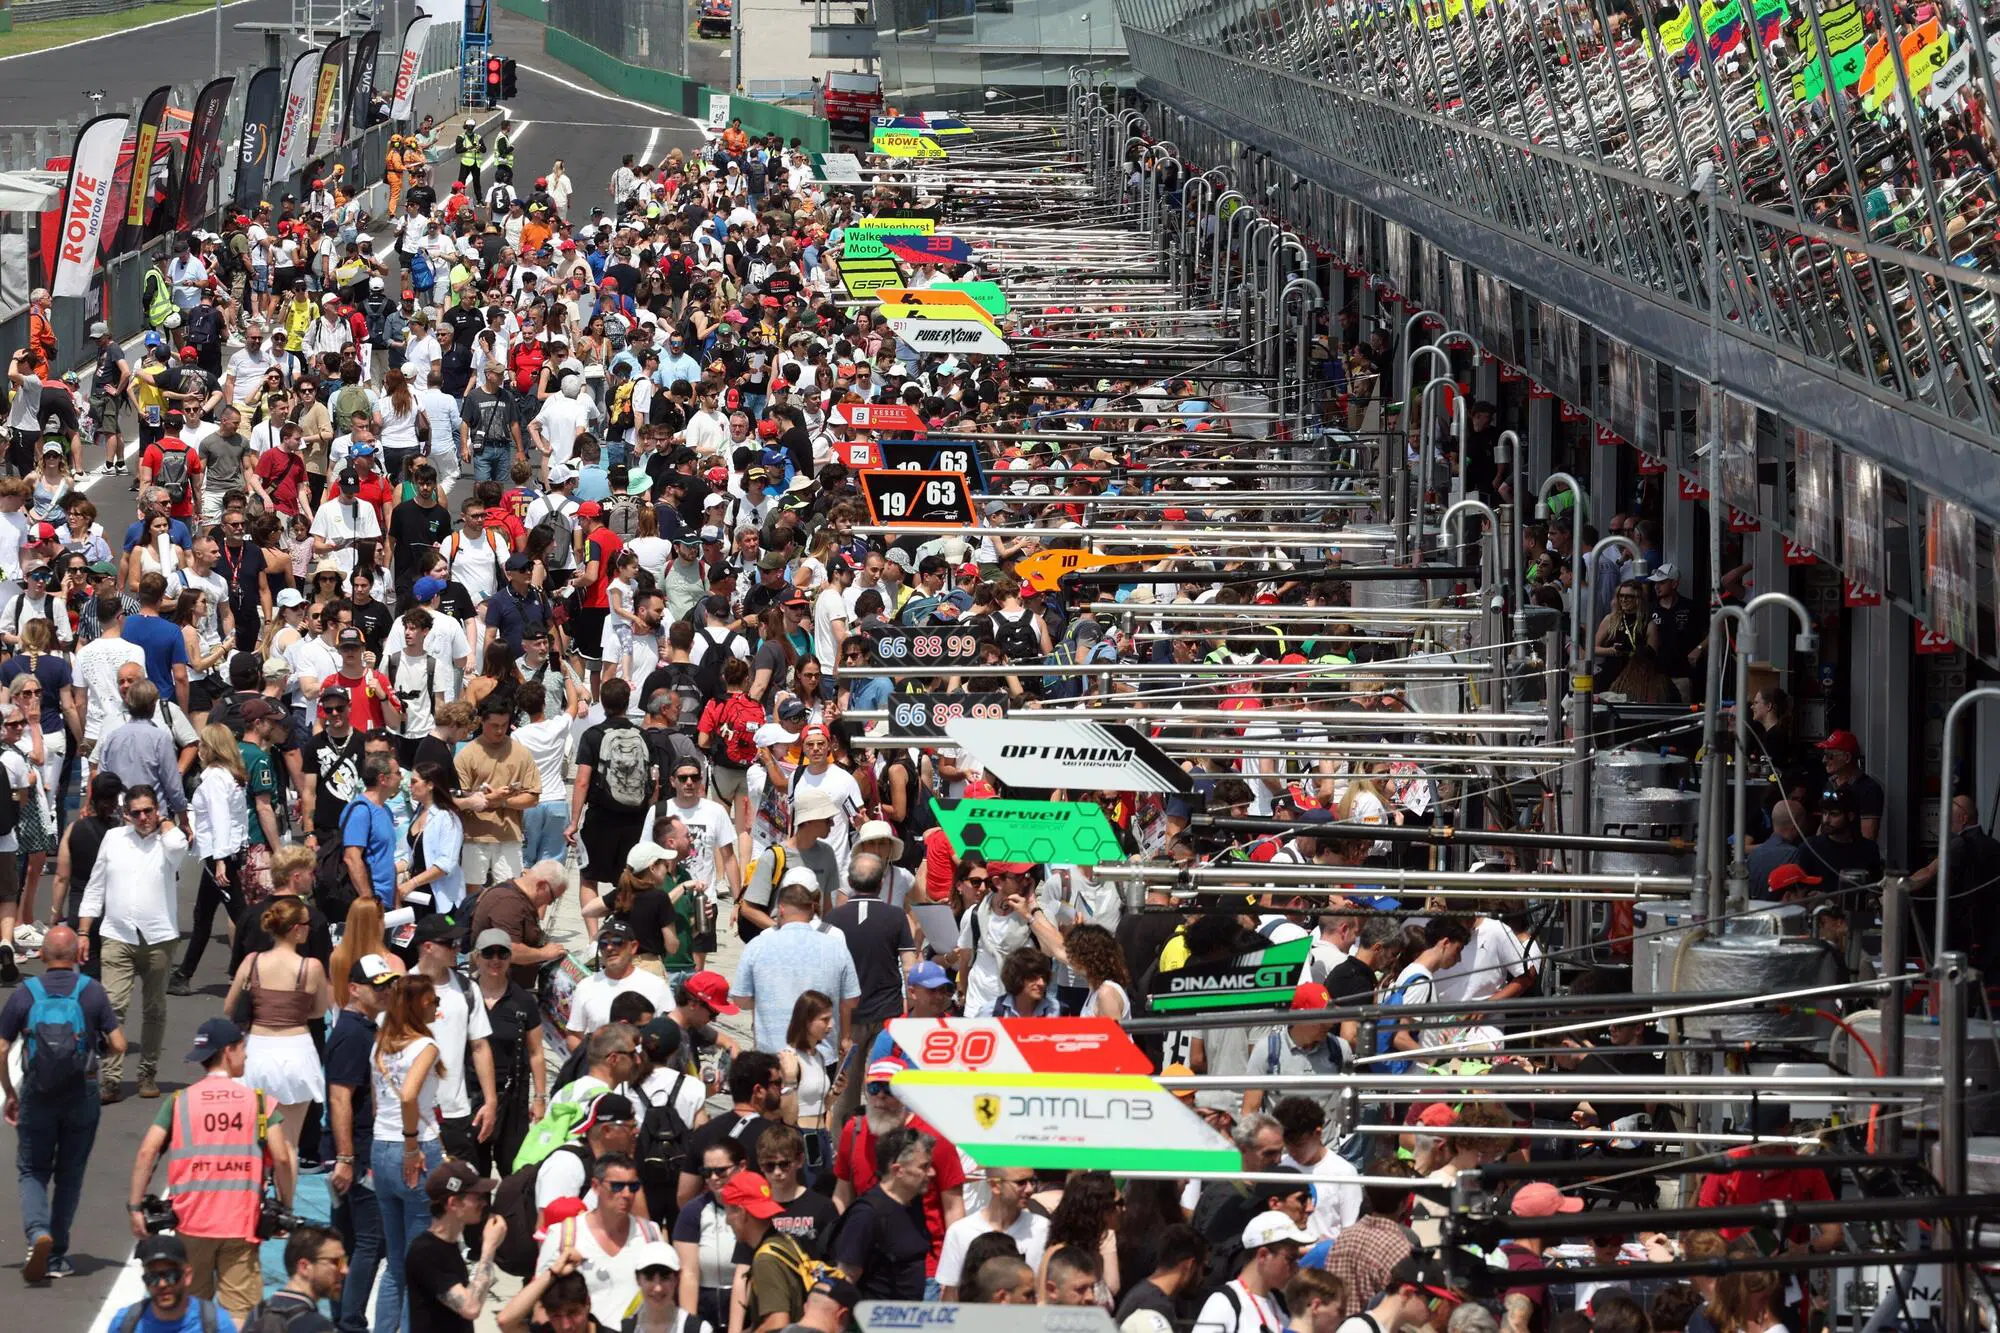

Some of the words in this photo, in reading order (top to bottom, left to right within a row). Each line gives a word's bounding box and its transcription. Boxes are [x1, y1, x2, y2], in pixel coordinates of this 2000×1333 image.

[395, 49, 416, 101] ROWE
[279, 93, 299, 157] ROWE
[291, 109, 301, 137] MOTOR
[877, 117, 896, 126] 97
[243, 122, 257, 163] aws
[887, 137, 919, 146] ROWE
[62, 171, 97, 264] ROWE
[89, 195, 103, 237] MOTOR
[98, 179, 108, 195] OIL
[927, 237, 952, 250] 33
[852, 280, 897, 289] GSP
[893, 322, 907, 330] 911
[856, 412, 864, 420] 8
[853, 450, 867, 460] 74
[940, 450, 968, 473] 63
[926, 480, 956, 505] 63
[879, 492, 906, 516] 19
[1062, 555, 1078, 567] 10
[878, 637, 907, 658] 66
[913, 636, 942, 657] 88
[947, 635, 976, 657] 99
[895, 703, 926, 727] 66
[933, 703, 964, 726] 88
[971, 703, 1003, 719] 99
[1000, 745, 1135, 762] OPTIMUM
[1062, 760, 1128, 768] MOTORSPORT
[969, 807, 1071, 821] Barwell
[921, 1028, 998, 1066] 80
[204, 1112, 243, 1132] 094
[192, 1162, 212, 1172] PIT
[217, 1162, 252, 1172] LANE
